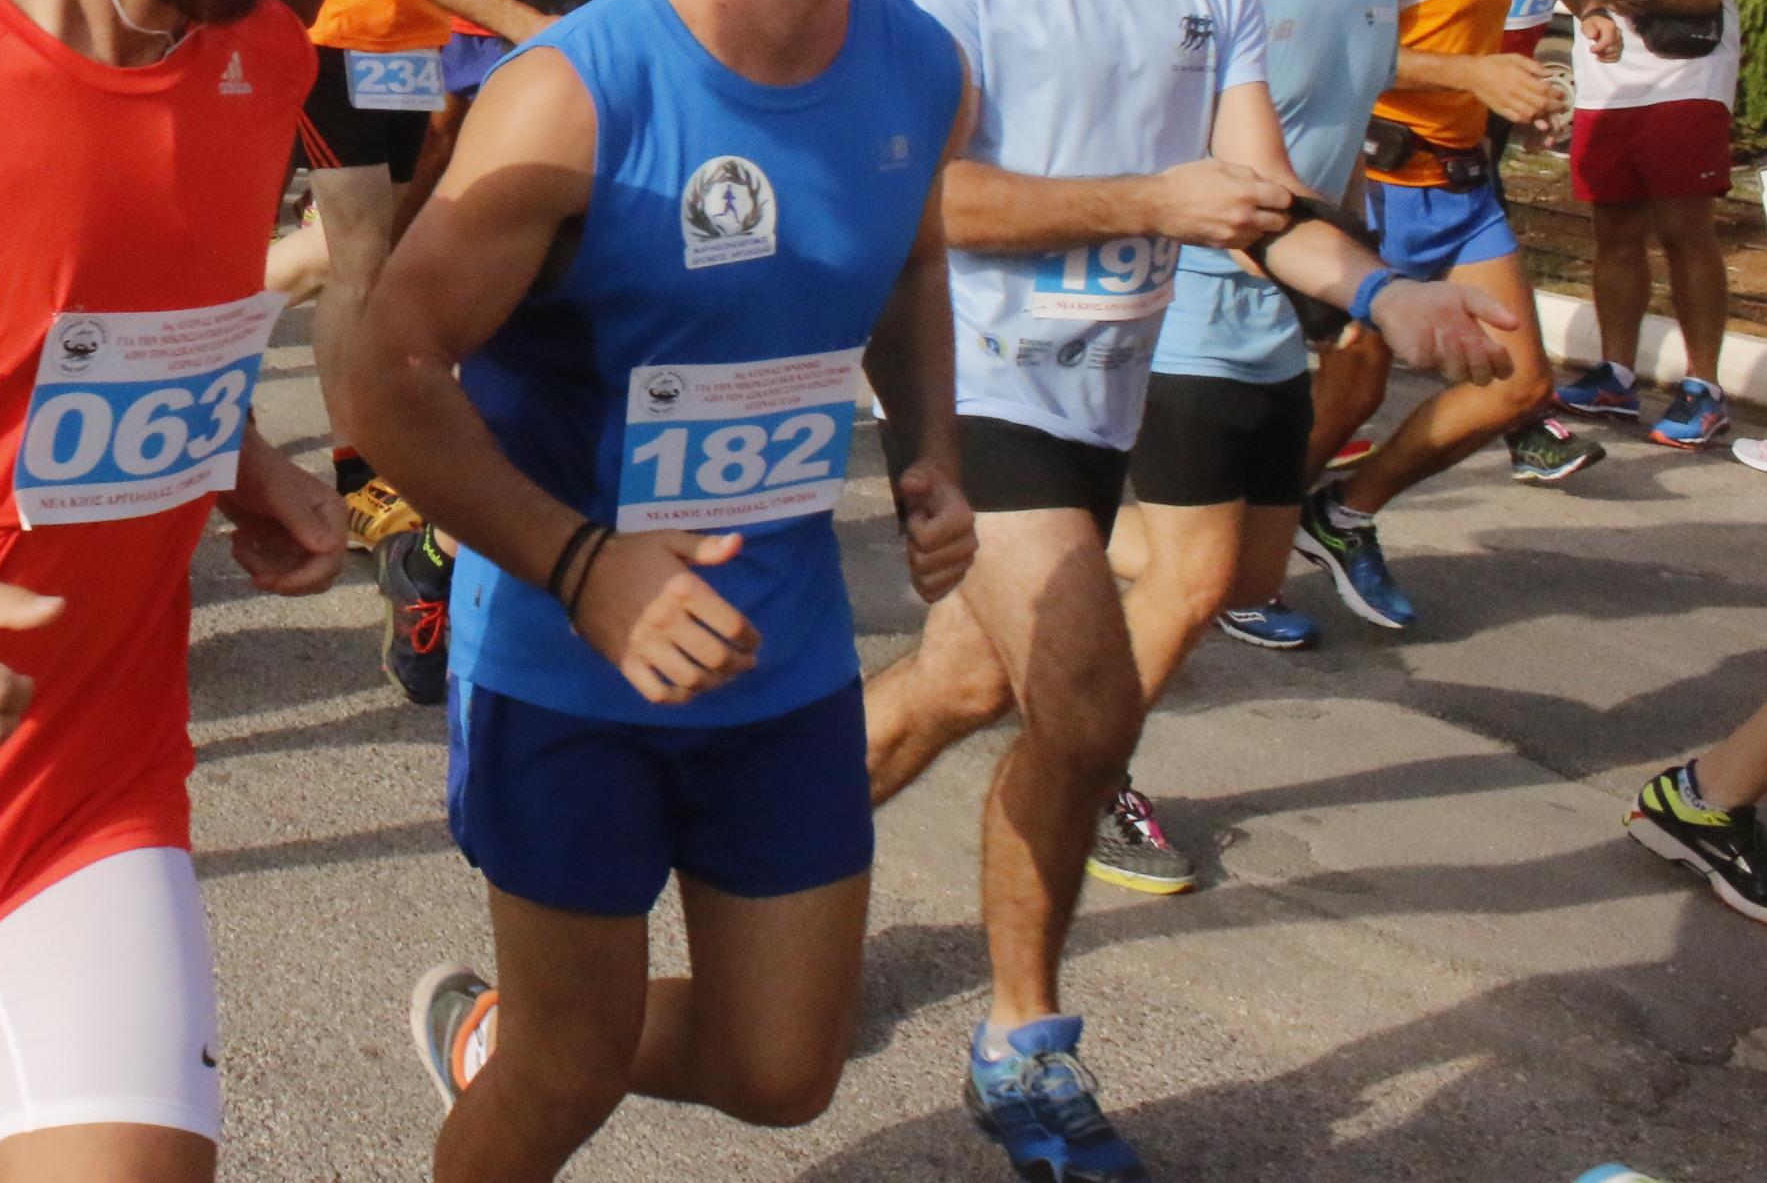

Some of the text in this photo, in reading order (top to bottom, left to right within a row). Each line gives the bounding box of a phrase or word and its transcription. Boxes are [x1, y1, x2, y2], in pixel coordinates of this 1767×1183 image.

[354, 59, 440, 93] 234
[1042, 236, 1178, 292] 199
[24, 369, 247, 480] 063
[632, 413, 836, 497] 182
